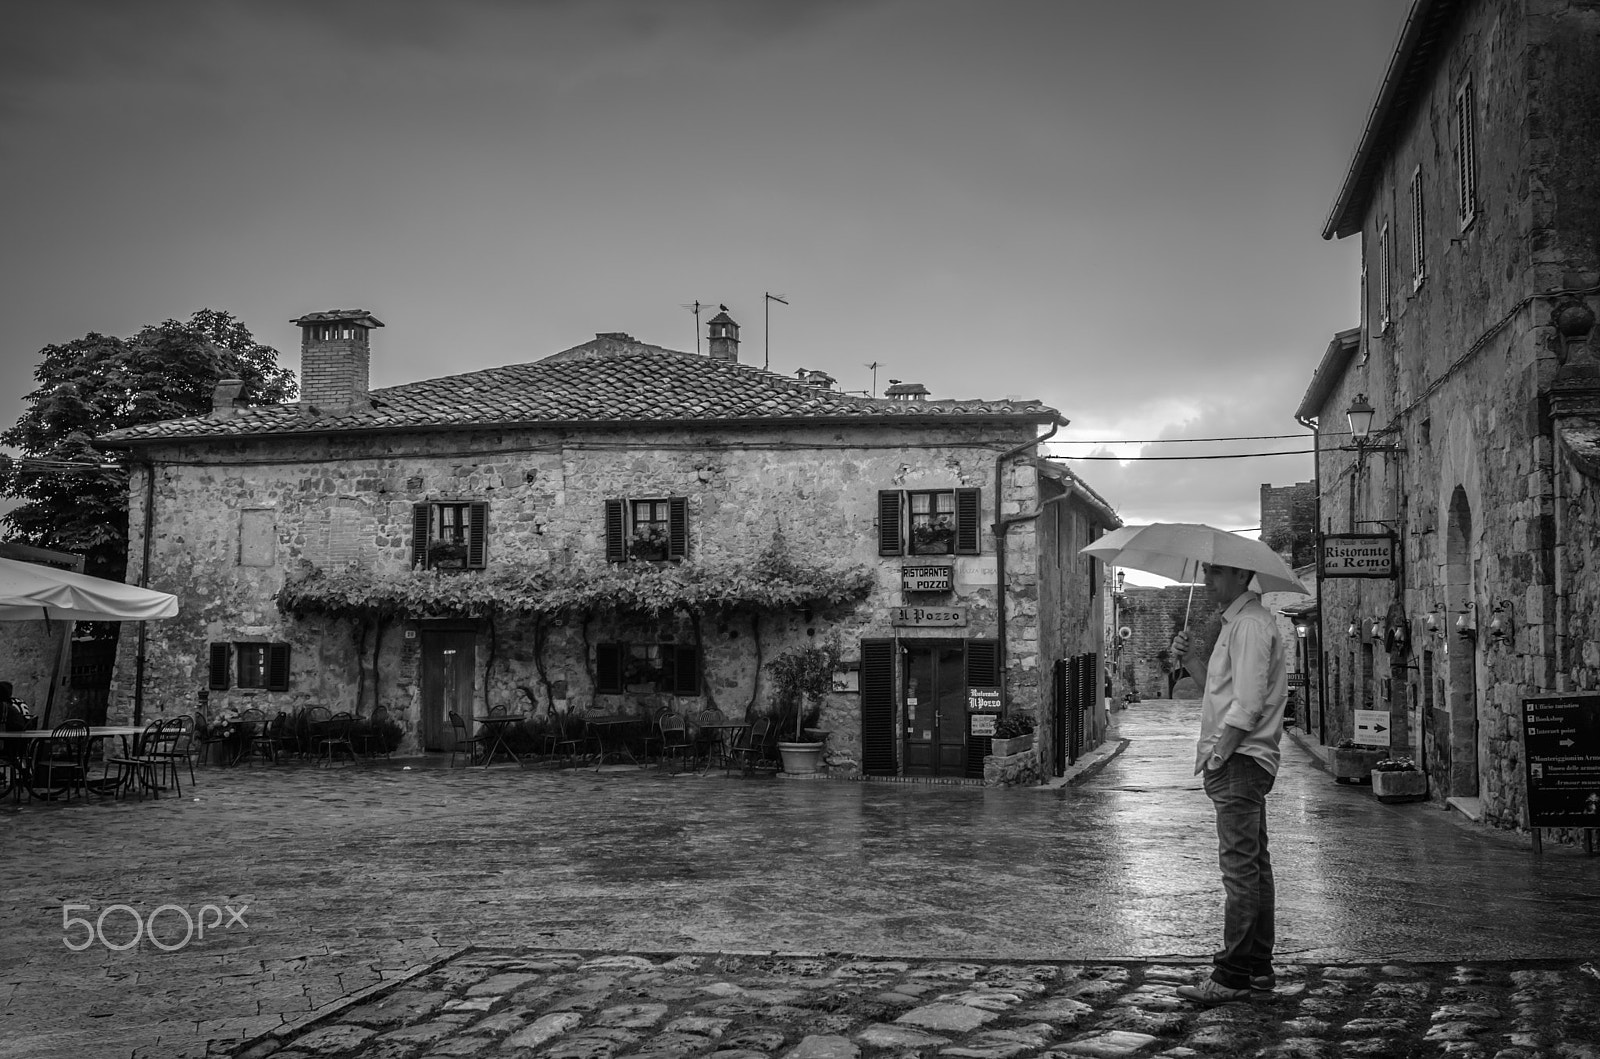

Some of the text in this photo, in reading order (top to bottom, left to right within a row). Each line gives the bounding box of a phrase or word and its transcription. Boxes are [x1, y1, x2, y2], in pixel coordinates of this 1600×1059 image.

[1325, 546, 1389, 558] Ristorante
[1325, 557, 1390, 568] da Remo
[903, 568, 948, 577] RISTORANTE
[903, 581, 948, 589] IL POZZO
[899, 608, 960, 624] Il Pozzo
[968, 697, 1001, 709] Il Pozzo
[1536, 715, 1564, 723] Bookshop
